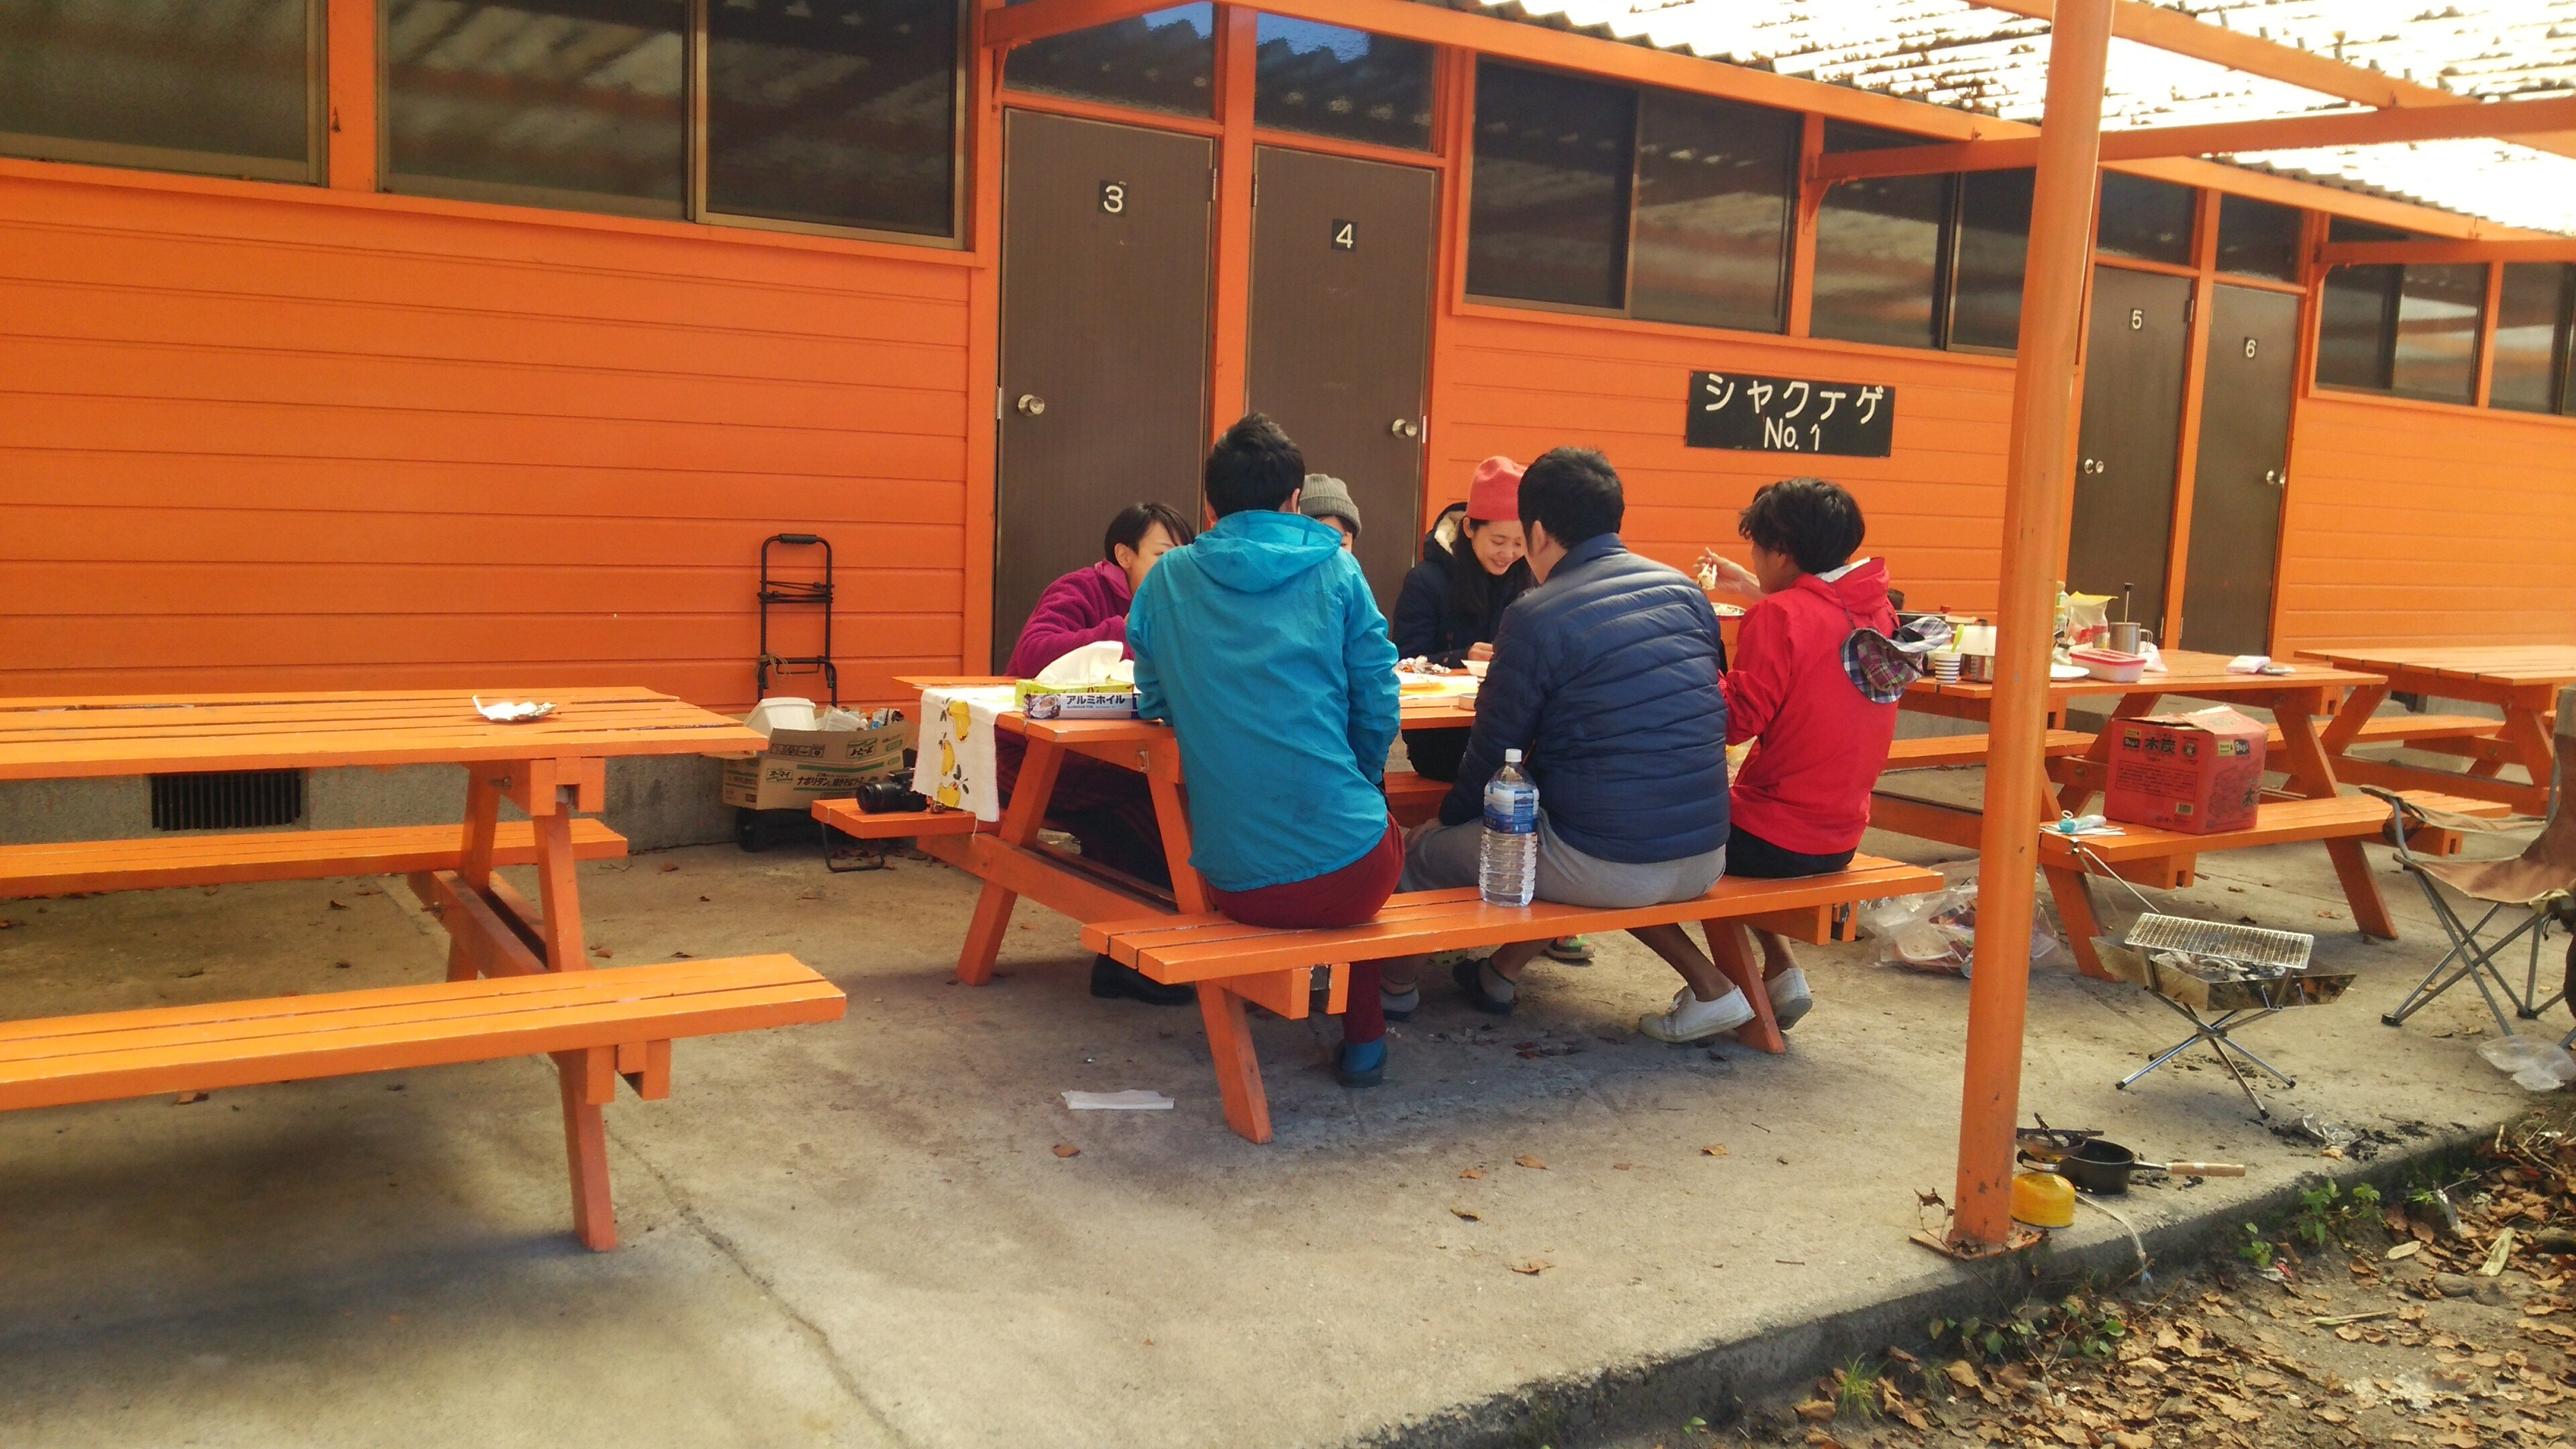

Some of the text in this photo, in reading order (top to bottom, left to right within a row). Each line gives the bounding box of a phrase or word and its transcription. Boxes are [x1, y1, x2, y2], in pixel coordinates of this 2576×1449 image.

[1104, 184, 1124, 213] 3
[1336, 223, 1354, 249] 4
[2131, 309, 2143, 329] 5
[2246, 339, 2257, 358] 6
[1764, 417, 1821, 451] No. 1
[1066, 694, 1126, 705] アルミホイル
